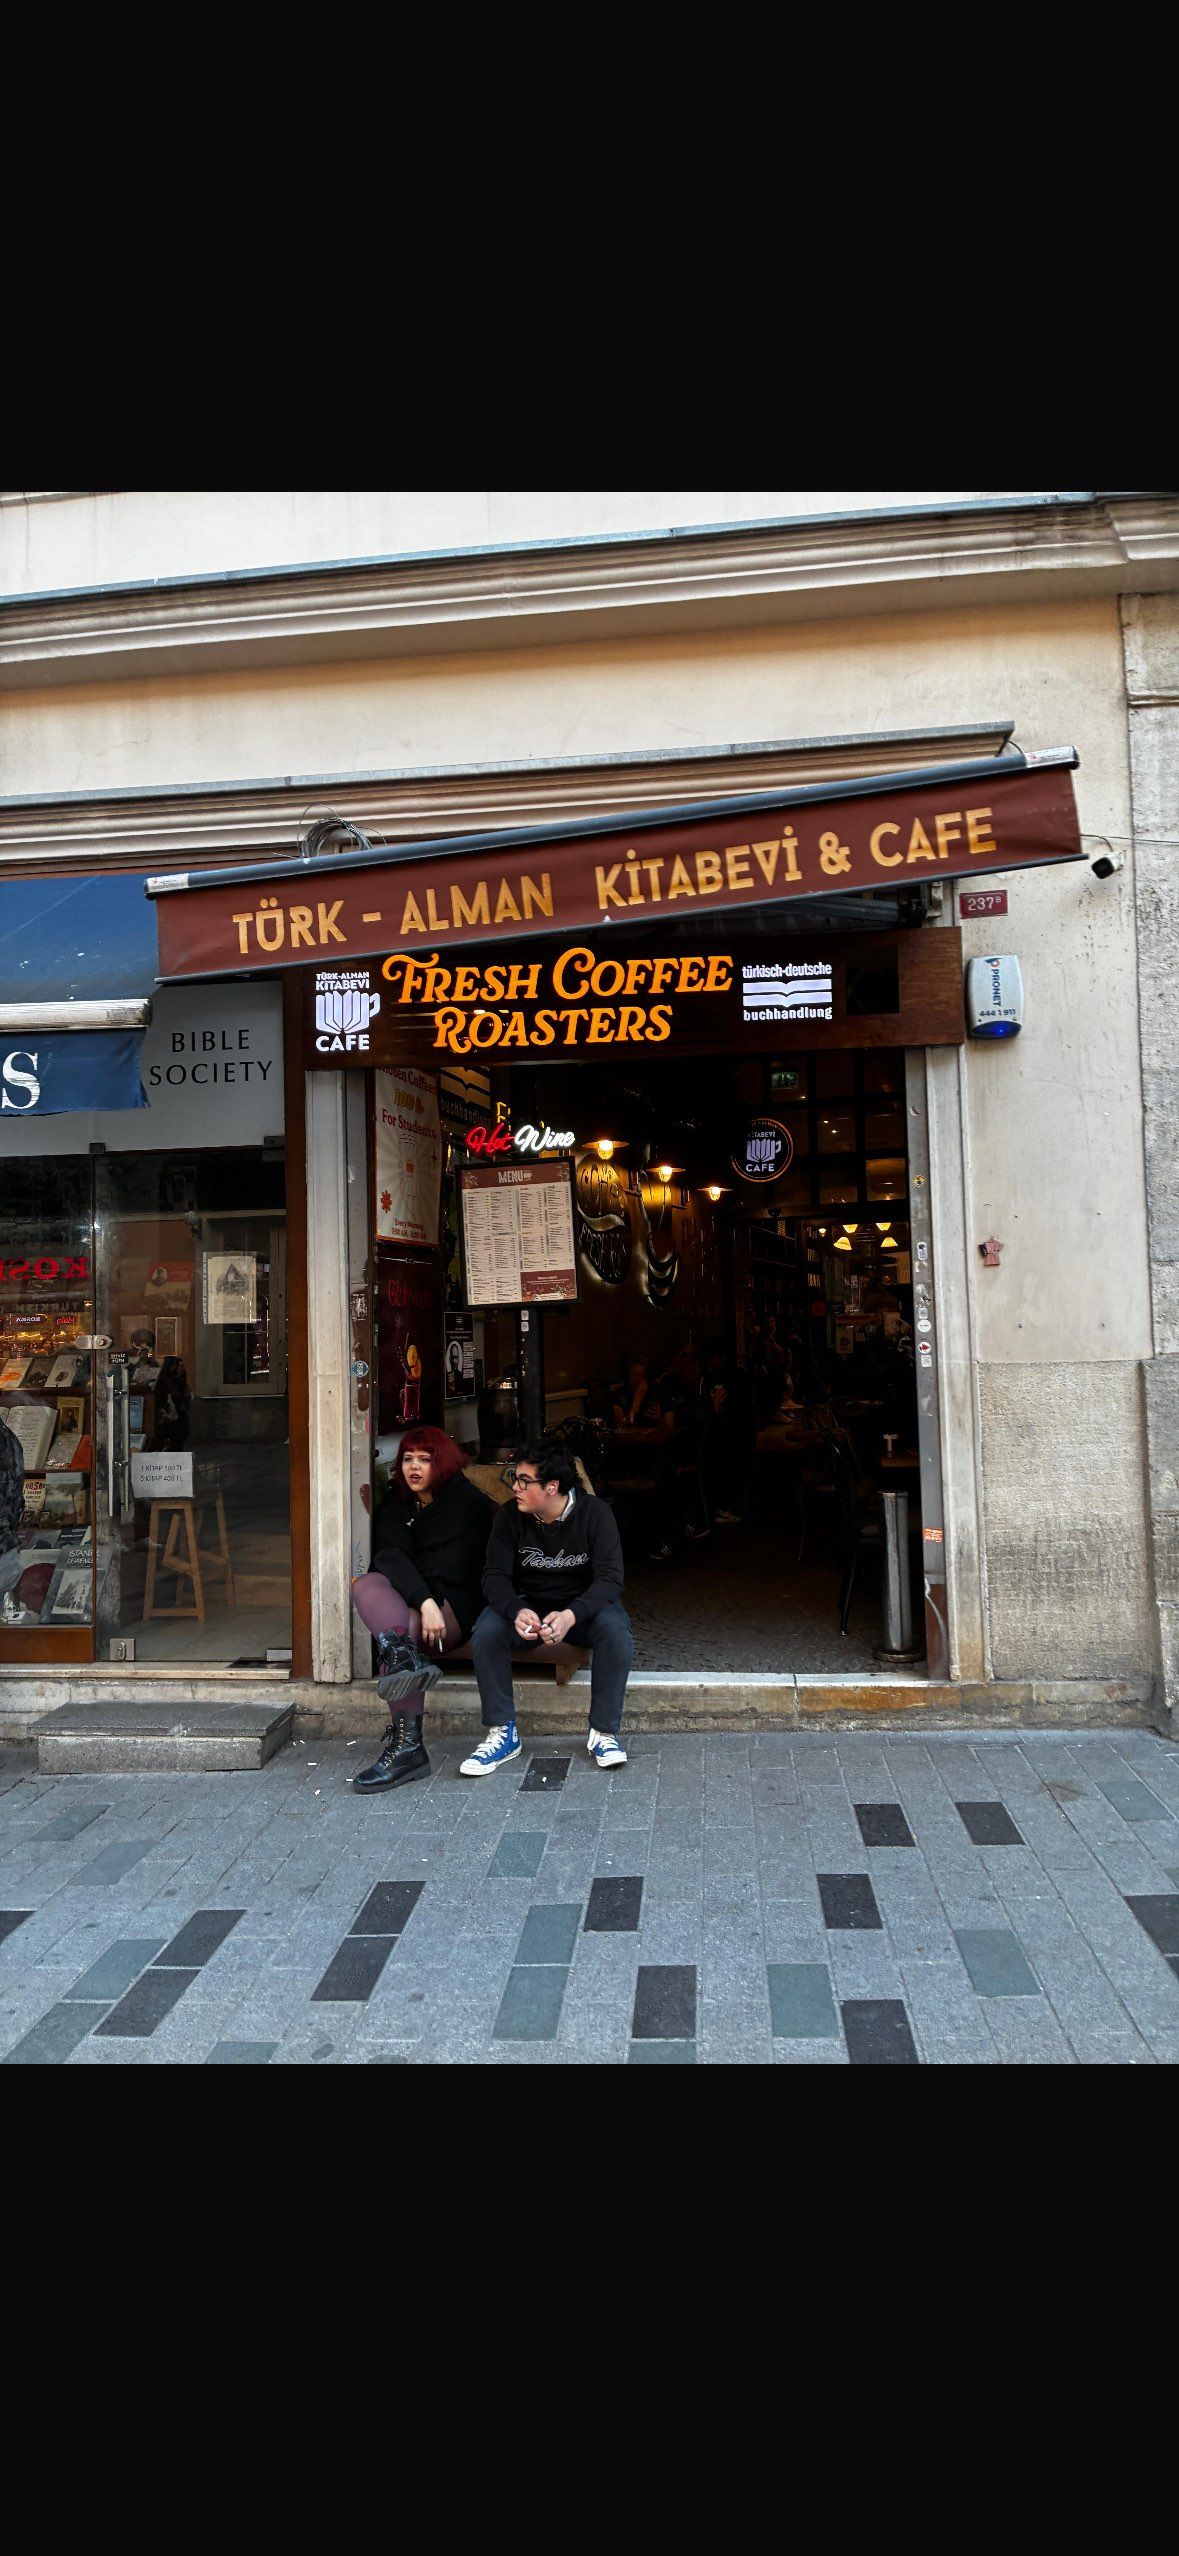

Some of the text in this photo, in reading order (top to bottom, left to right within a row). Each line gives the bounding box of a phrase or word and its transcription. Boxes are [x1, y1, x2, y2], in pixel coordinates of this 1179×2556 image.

[232, 897, 348, 954] TÜRK
[400, 872, 554, 935] ALMAN
[595, 825, 803, 911] KİTABEVİ
[818, 831, 853, 876] &
[869, 807, 998, 868] CAFE
[315, 971, 370, 980] TÜRK-ALMAN
[381, 947, 734, 1003] FRESH COFFEE
[742, 962, 833, 979] türkisch-deutsche
[991, 968, 1003, 1007] PRONET
[743, 1005, 833, 1022] buchhandlung
[171, 1029, 250, 1053] BIBLE
[432, 1005, 674, 1054] ROASTERS
[315, 1033, 370, 1052] CAFE
[1, 1051, 41, 1109] S
[149, 1060, 273, 1086] SOCIETY
[381, 1107, 397, 1128] For
[464, 1123, 576, 1154] Hot Wine
[498, 1169, 523, 1184] MENU
[745, 1163, 775, 1172] CAFE
